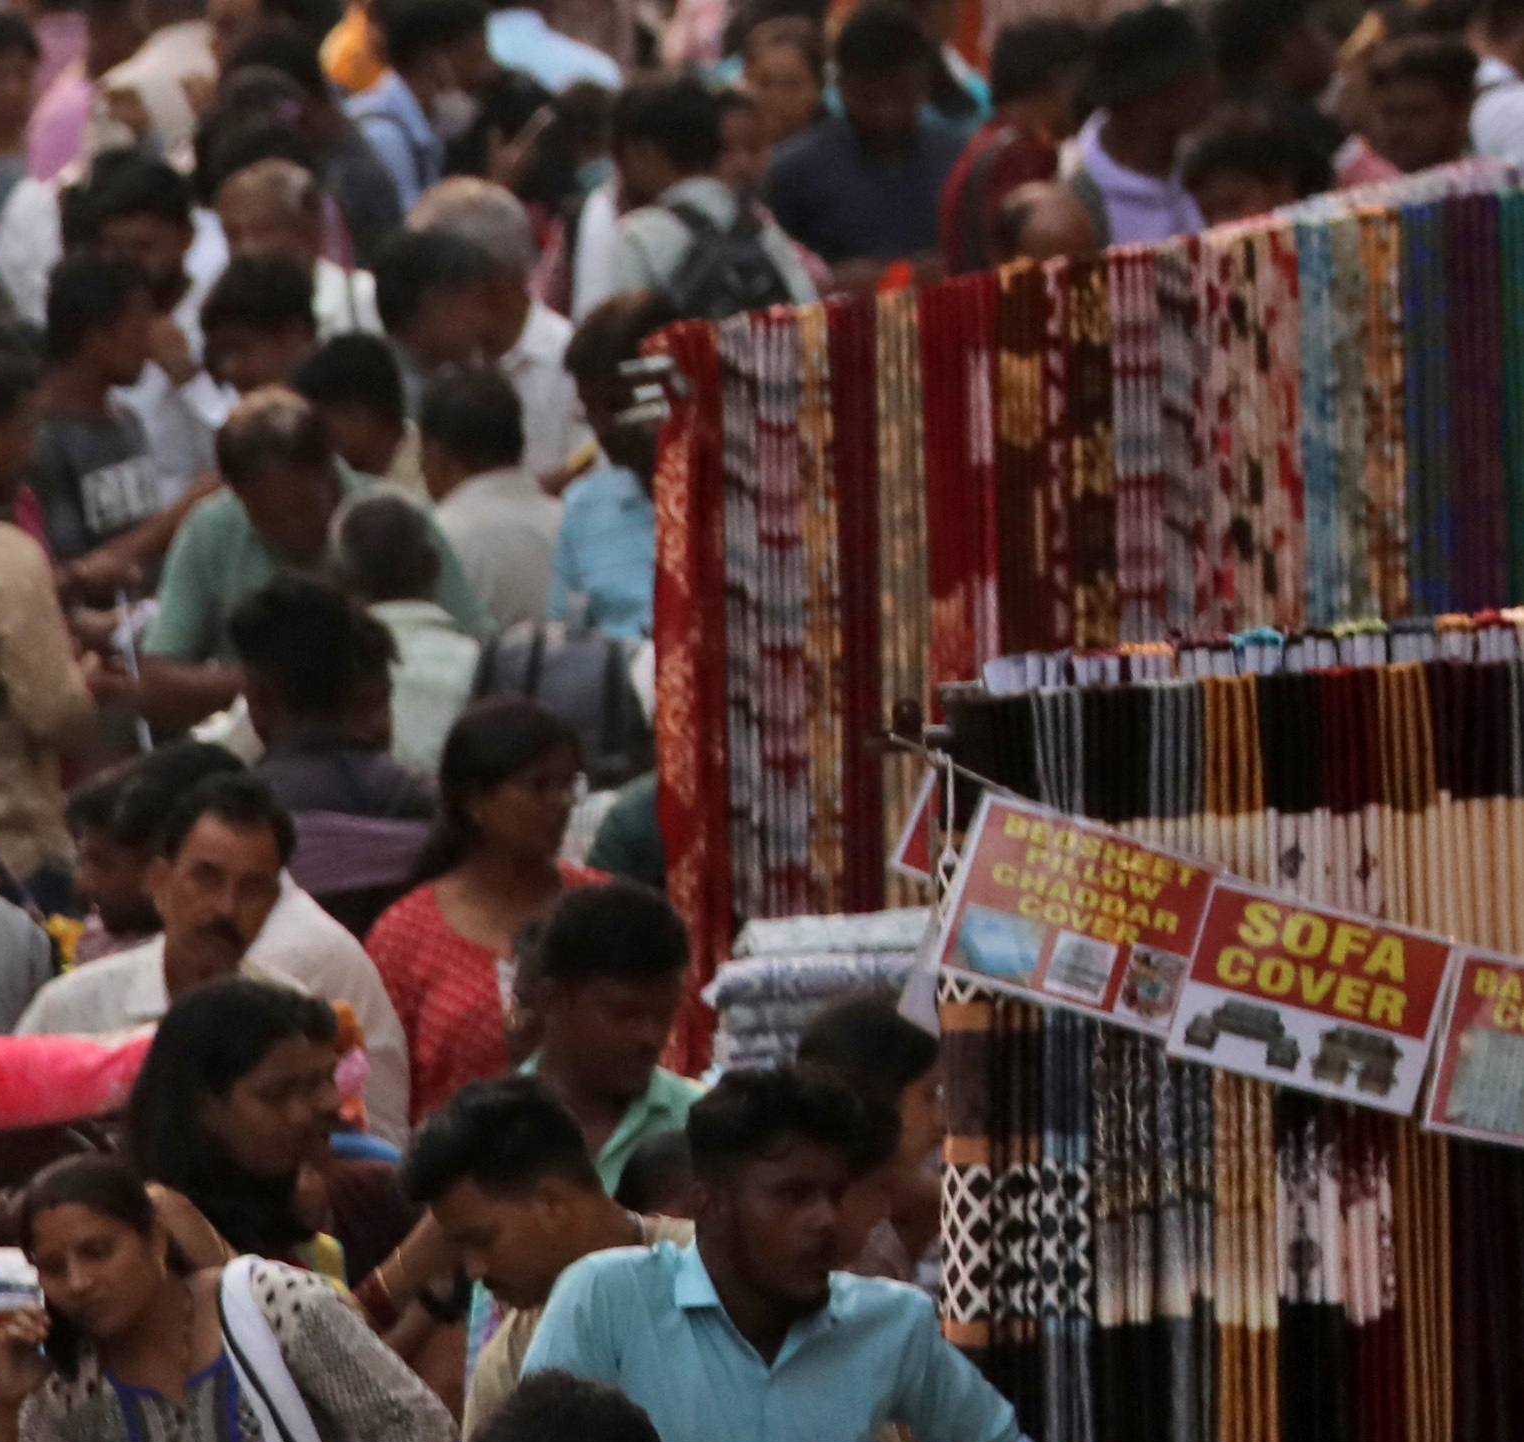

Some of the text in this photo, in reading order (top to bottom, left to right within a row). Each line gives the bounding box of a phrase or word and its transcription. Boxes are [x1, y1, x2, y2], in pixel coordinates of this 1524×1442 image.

[1025, 845, 1163, 900] PILLOW
[1016, 894, 1141, 946] COVER
[1237, 901, 1406, 983] SOFA
[1216, 944, 1408, 1027] COVER
[1473, 967, 1524, 1001] BA
